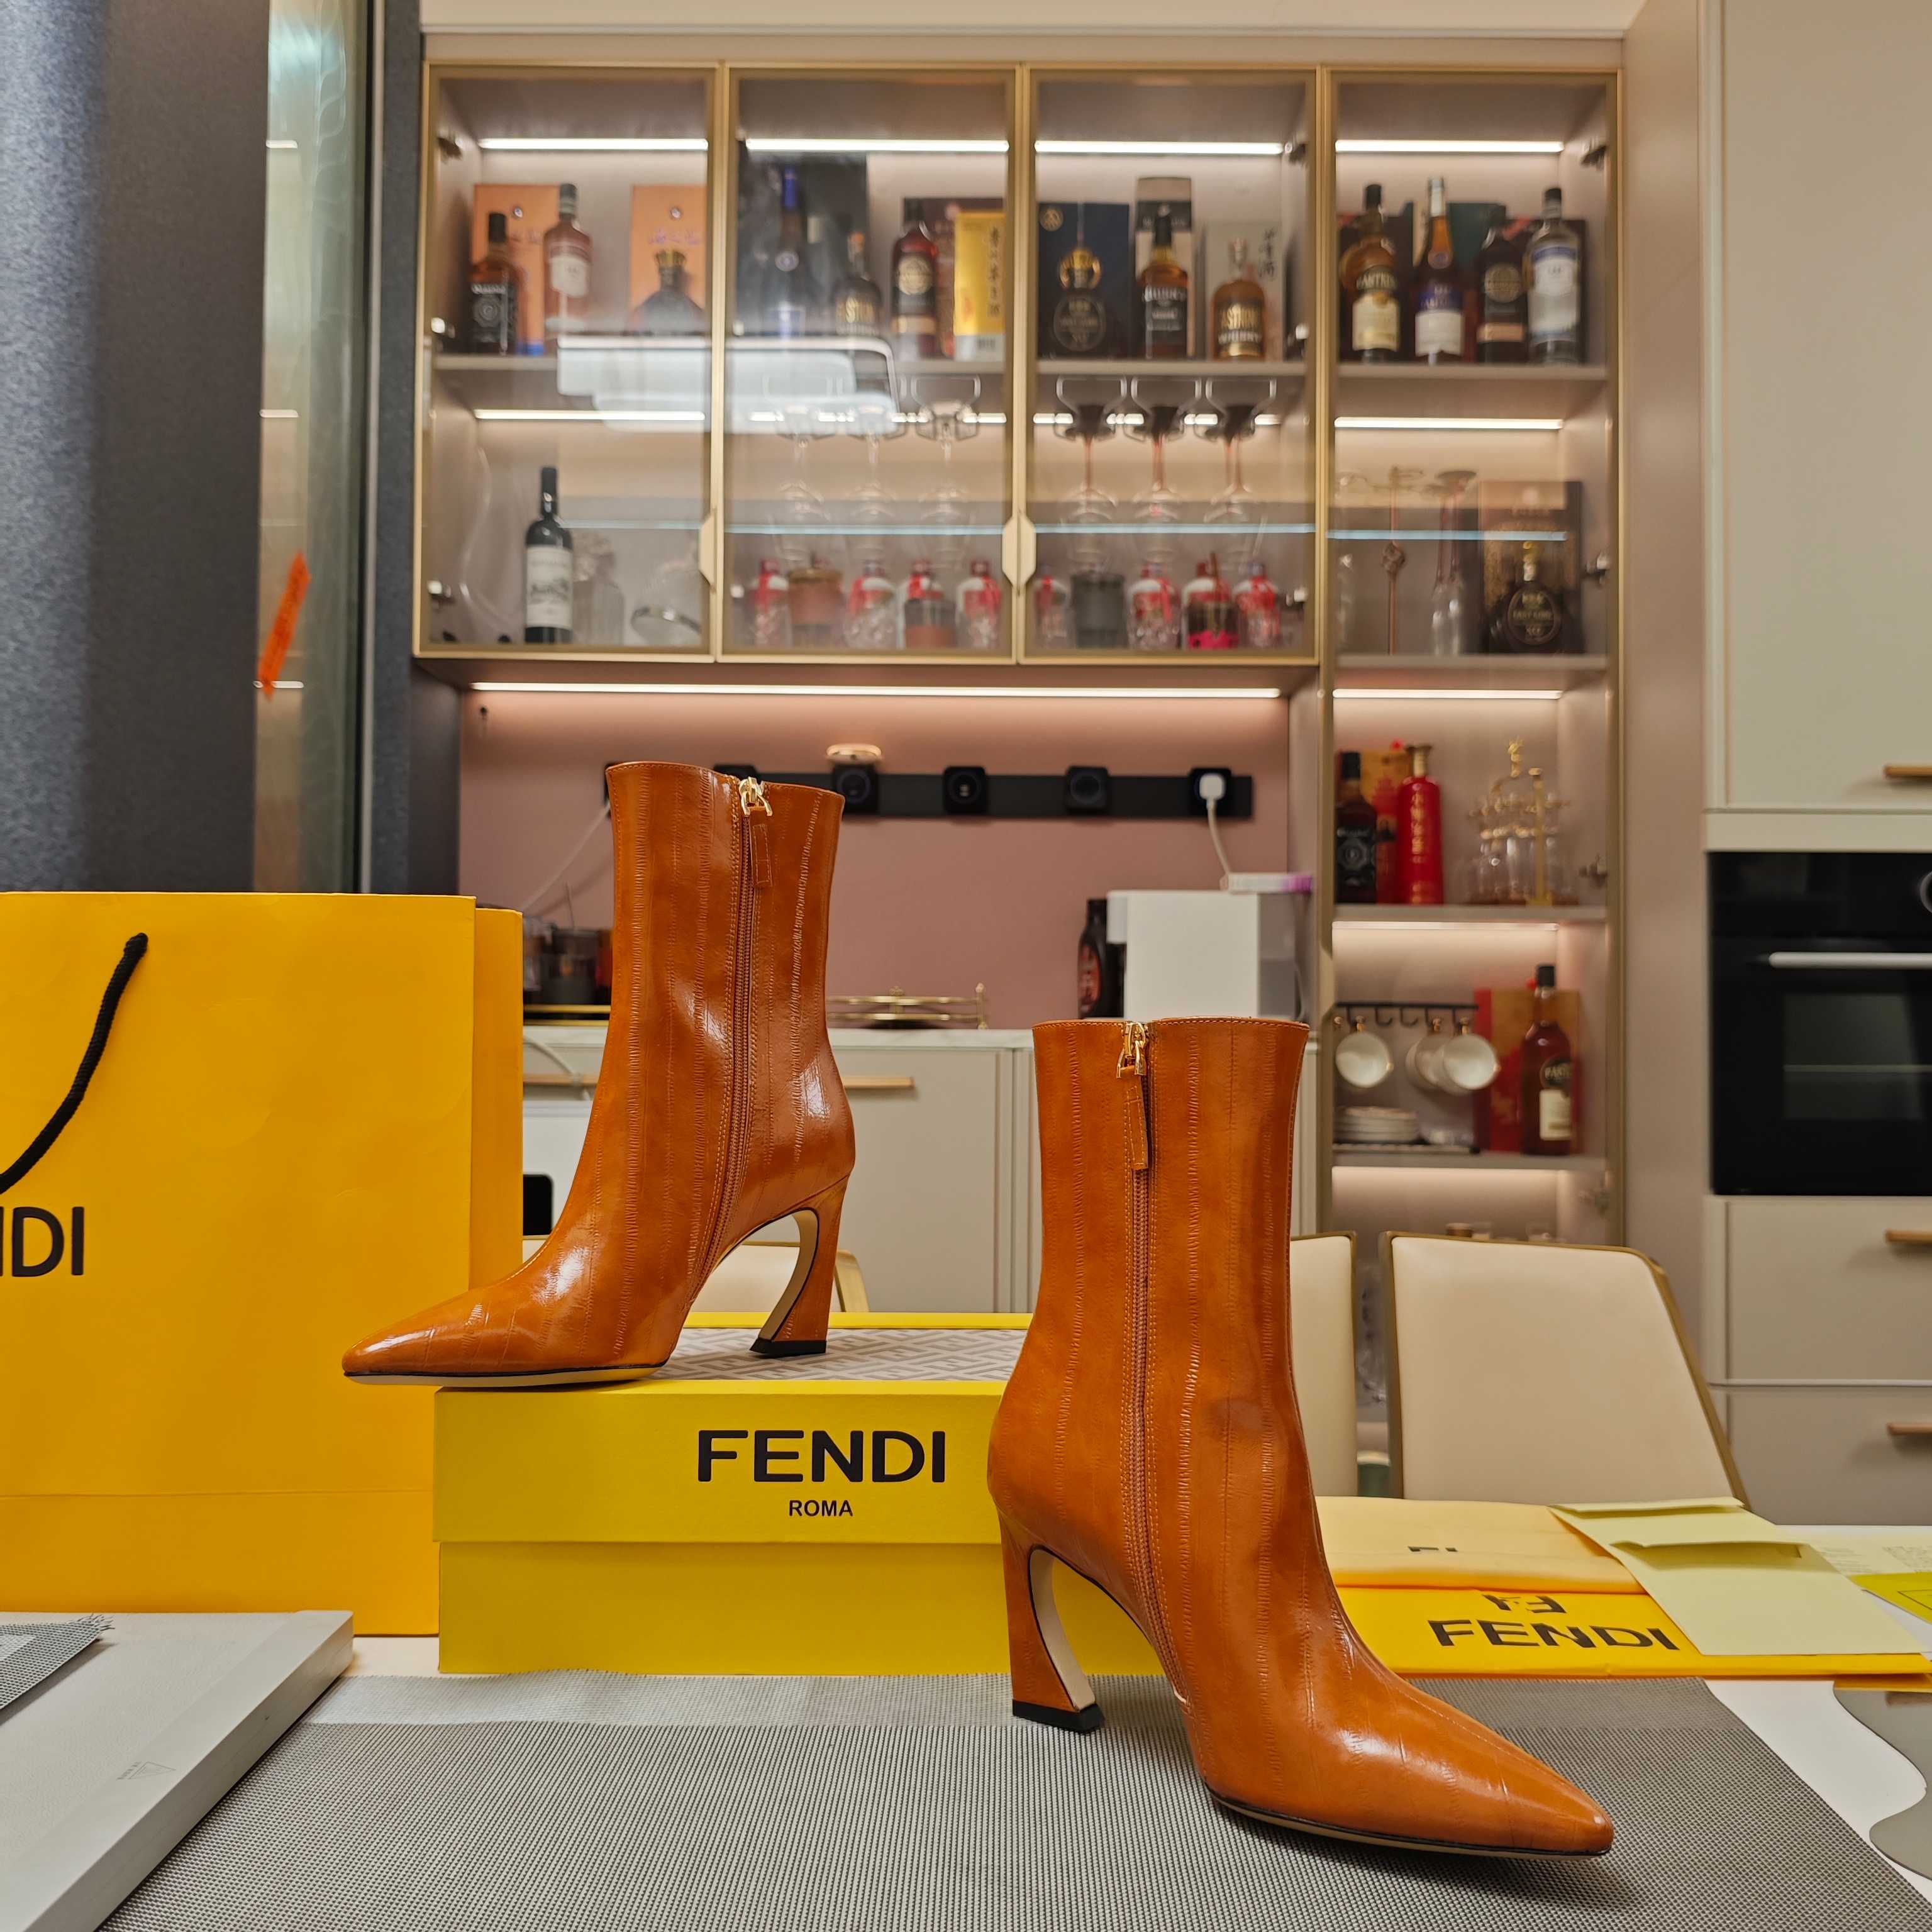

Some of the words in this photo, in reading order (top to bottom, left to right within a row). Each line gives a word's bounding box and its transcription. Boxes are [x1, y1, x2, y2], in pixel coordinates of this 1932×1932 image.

[0, 1206, 84, 1277] DI
[698, 1430, 945, 1482] FENDI
[789, 1500, 853, 1516] ROMA
[1428, 1619, 1680, 1650] FENDI
